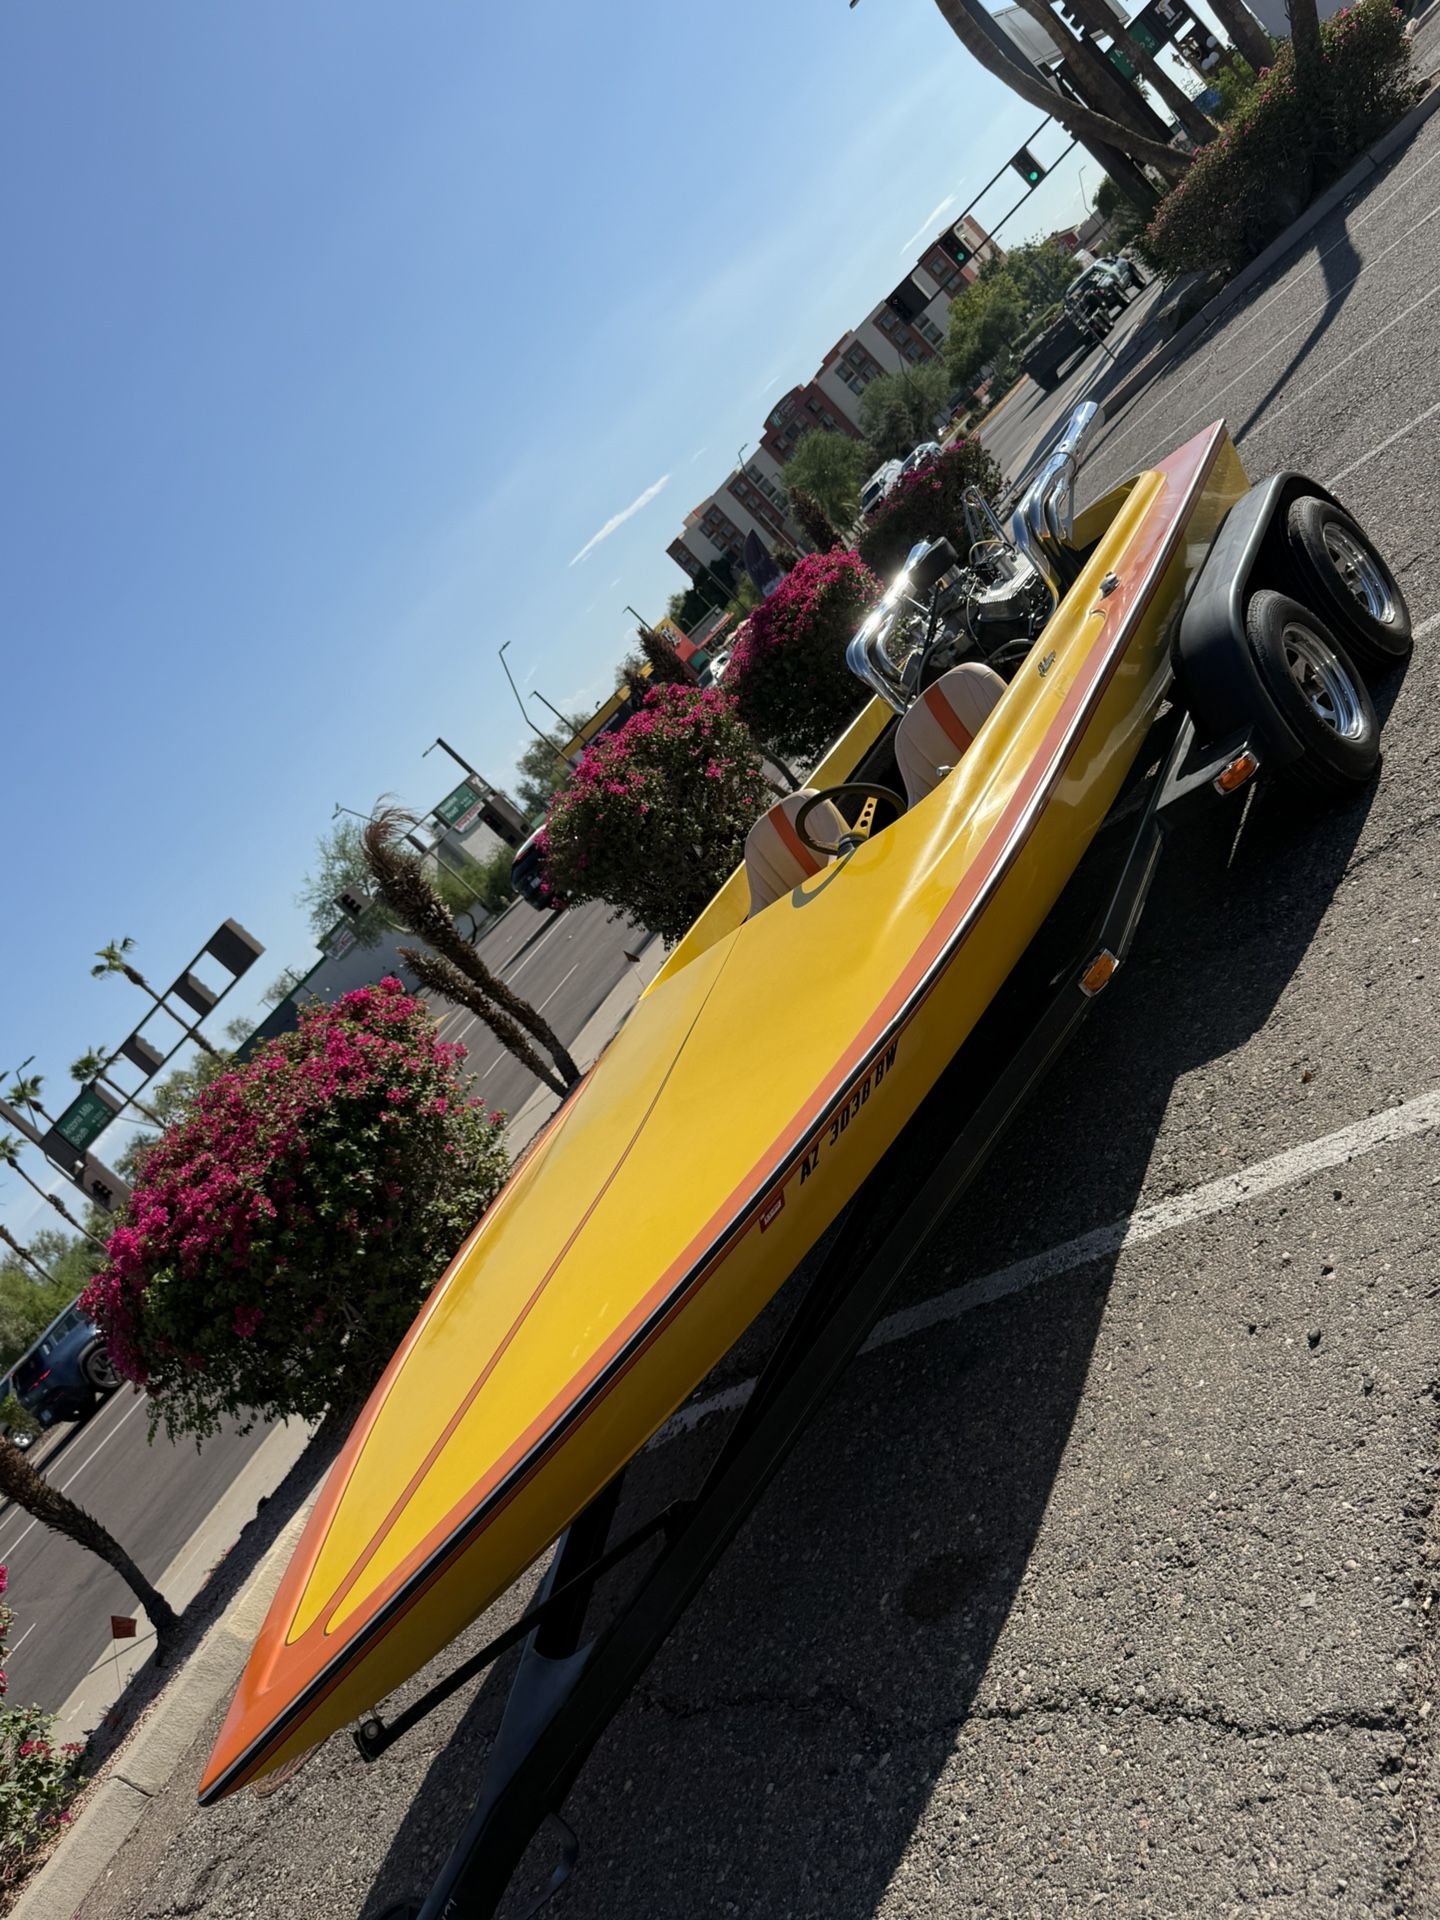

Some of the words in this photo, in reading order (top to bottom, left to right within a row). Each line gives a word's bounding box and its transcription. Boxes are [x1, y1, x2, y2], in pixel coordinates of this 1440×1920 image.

[800, 1142, 820, 1186] AZ
[828, 1076, 872, 1146] 3038
[874, 1038, 899, 1089] BW
